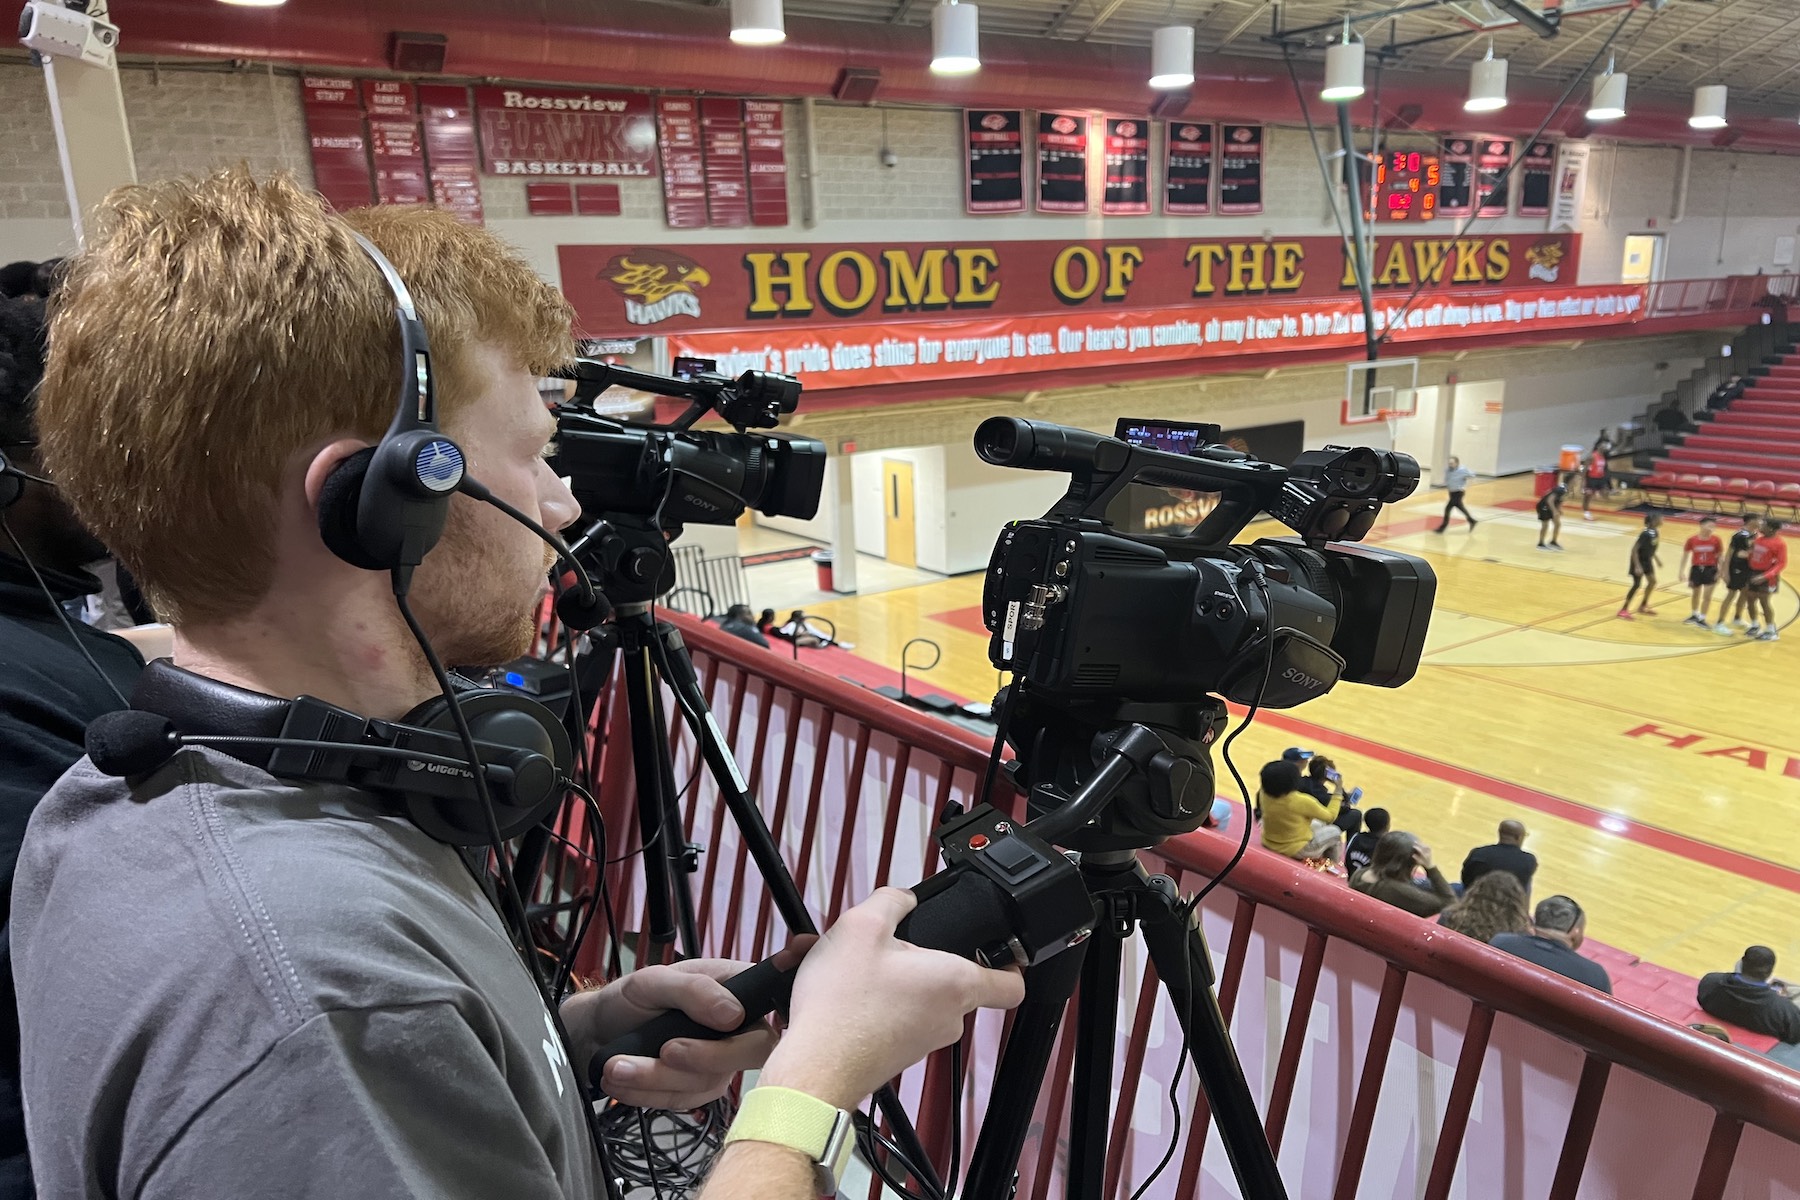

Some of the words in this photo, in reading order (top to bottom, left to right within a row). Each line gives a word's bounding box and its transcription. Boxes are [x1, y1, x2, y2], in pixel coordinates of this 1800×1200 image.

[503, 91, 628, 112] Rossview
[494, 161, 650, 176] BASKETBALL
[744, 247, 1001, 318] HOME
[1052, 245, 1143, 307] OF
[1185, 242, 1305, 296] THE
[1342, 239, 1511, 288] HAWKS
[624, 292, 701, 325] HAWKS
[831, 341, 872, 371] does
[874, 337, 916, 367] shine
[917, 336, 943, 364] for
[945, 334, 1011, 364] everyone
[1012, 331, 1027, 357] to
[1027, 332, 1056, 356] see.
[1058, 325, 1084, 353] Our
[1128, 325, 1151, 352] you
[1221, 319, 1246, 344] may
[1256, 317, 1283, 339] ever
[684, 494, 720, 511] SONY
[1282, 667, 1323, 690] SONY
[1623, 723, 1800, 779] HA
